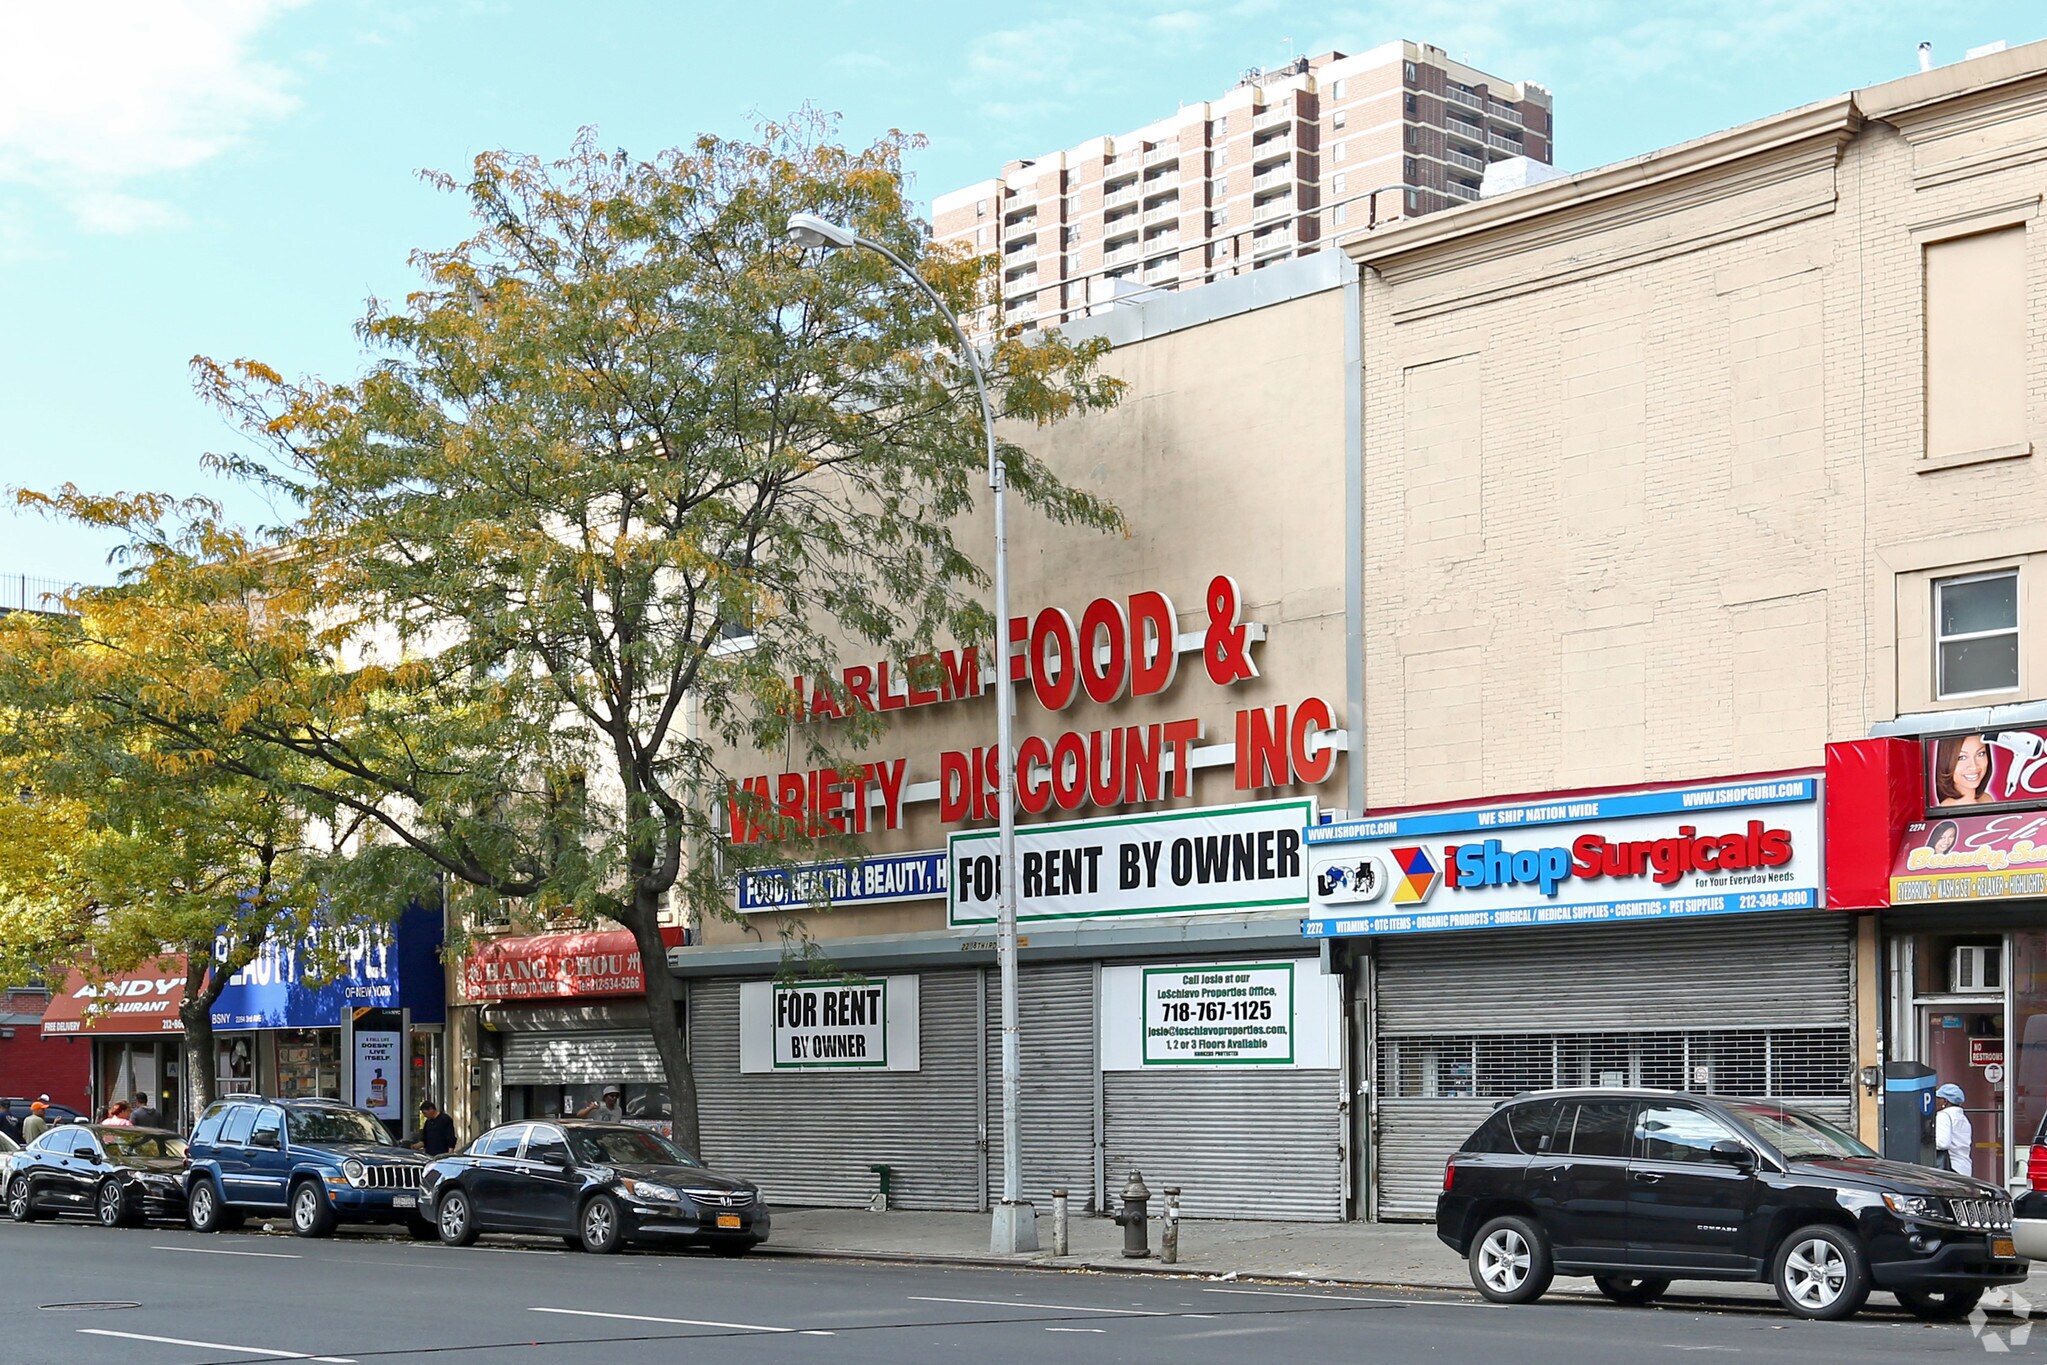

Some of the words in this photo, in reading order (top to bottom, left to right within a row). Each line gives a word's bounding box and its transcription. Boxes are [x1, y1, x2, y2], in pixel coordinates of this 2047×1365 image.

[995, 590, 1176, 711] FOOD
[1204, 575, 1258, 685] &
[728, 758, 908, 844] VARIETY
[940, 719, 1200, 823] DISCOUNT
[1235, 697, 1334, 785] INC
[1682, 782, 1803, 807] WWW.ISHOPGURU.COM
[1478, 811, 1496, 825] WE
[1498, 809, 1525, 823] SHIP
[1526, 806, 1567, 822] NATION
[1568, 803, 1599, 818] WIDE
[1307, 822, 1397, 841] WWW.ISHOPOTC.COM
[1908, 823, 1926, 832] 2274
[959, 853, 1001, 902] FO
[1023, 846, 1103, 897] RENT
[1120, 841, 1162, 890] BY
[1171, 829, 1300, 886] OWNER
[1907, 844, 2010, 871] Beauty
[746, 873, 790, 905] FOOD,
[850, 867, 861, 896] &
[864, 860, 932, 895] BEAUTY,
[1695, 878, 1708, 888] For
[1709, 876, 1728, 887] Your
[1729, 873, 1766, 887] Everyday
[1768, 871, 1795, 883] Needs
[1937, 879, 1954, 898] WASH
[1954, 879, 1960, 898] &
[1960, 878, 1971, 898] SET
[1977, 876, 2003, 896] RELAXER
[2009, 873, 2044, 894] HIGHLIGHTS
[1739, 891, 1807, 908] 212-348-4800
[1306, 923, 1323, 934] 2272
[1336, 920, 1369, 934] VITAMINS
[1374, 918, 1389, 931] OTC
[1389, 917, 1411, 930] ITEMS
[1416, 915, 1449, 930] ORGANIC
[1450, 912, 1489, 928] PRODUCTS
[1494, 909, 1531, 925] SURGICAL
[1538, 907, 1572, 922] MEDICAL
[1573, 905, 1609, 920] SUPPLIES
[1615, 903, 1661, 918] COSMETICS
[1669, 899, 1685, 913] PET
[1685, 897, 1725, 912] SUPPLIES
[304, 922, 390, 980] SPPLY
[485, 958, 547, 982] HANG
[560, 953, 624, 978] CHOU
[72, 977, 187, 998] ANDY'
[483, 983, 508, 996] CHINESE
[511, 981, 527, 995] FOOD
[528, 981, 538, 994] TO
[539, 980, 555, 993] TAKE
[1182, 974, 1200, 985] Call
[1200, 974, 1224, 985] Josie
[1224, 973, 1234, 984] at
[1235, 973, 1251, 983] our
[345, 987, 355, 998] OF
[356, 987, 372, 998] NEW
[373, 985, 392, 997] YORK
[1157, 988, 1200, 999] LoSchiavo
[1201, 986, 1247, 999] Properties
[1248, 985, 1278, 997] Office,
[86, 1001, 170, 1013] RSAURANT
[778, 991, 817, 1028] FOR
[823, 989, 881, 1027] RENT
[1162, 1000, 1271, 1022] 718-767-1125
[44, 1021, 57, 1032] FREE
[57, 1021, 81, 1032] DELIVERY
[212, 1013, 231, 1025] BSNY
[791, 1035, 809, 1058] BY
[812, 1034, 866, 1058] OWNER
[1166, 1040, 1172, 1050] 1,
[1173, 1040, 1179, 1049] 2
[1180, 1040, 1189, 1049] or
[1191, 1040, 1197, 1049] 3
[1199, 1039, 1226, 1049] Floors
[1227, 1038, 1268, 1049] Available
[1973, 1043, 1982, 1052] NO
[1972, 1052, 2003, 1061] RESTROOMS
[1924, 1092, 1932, 1112] P
[1696, 1224, 1738, 1232] COMPASS
